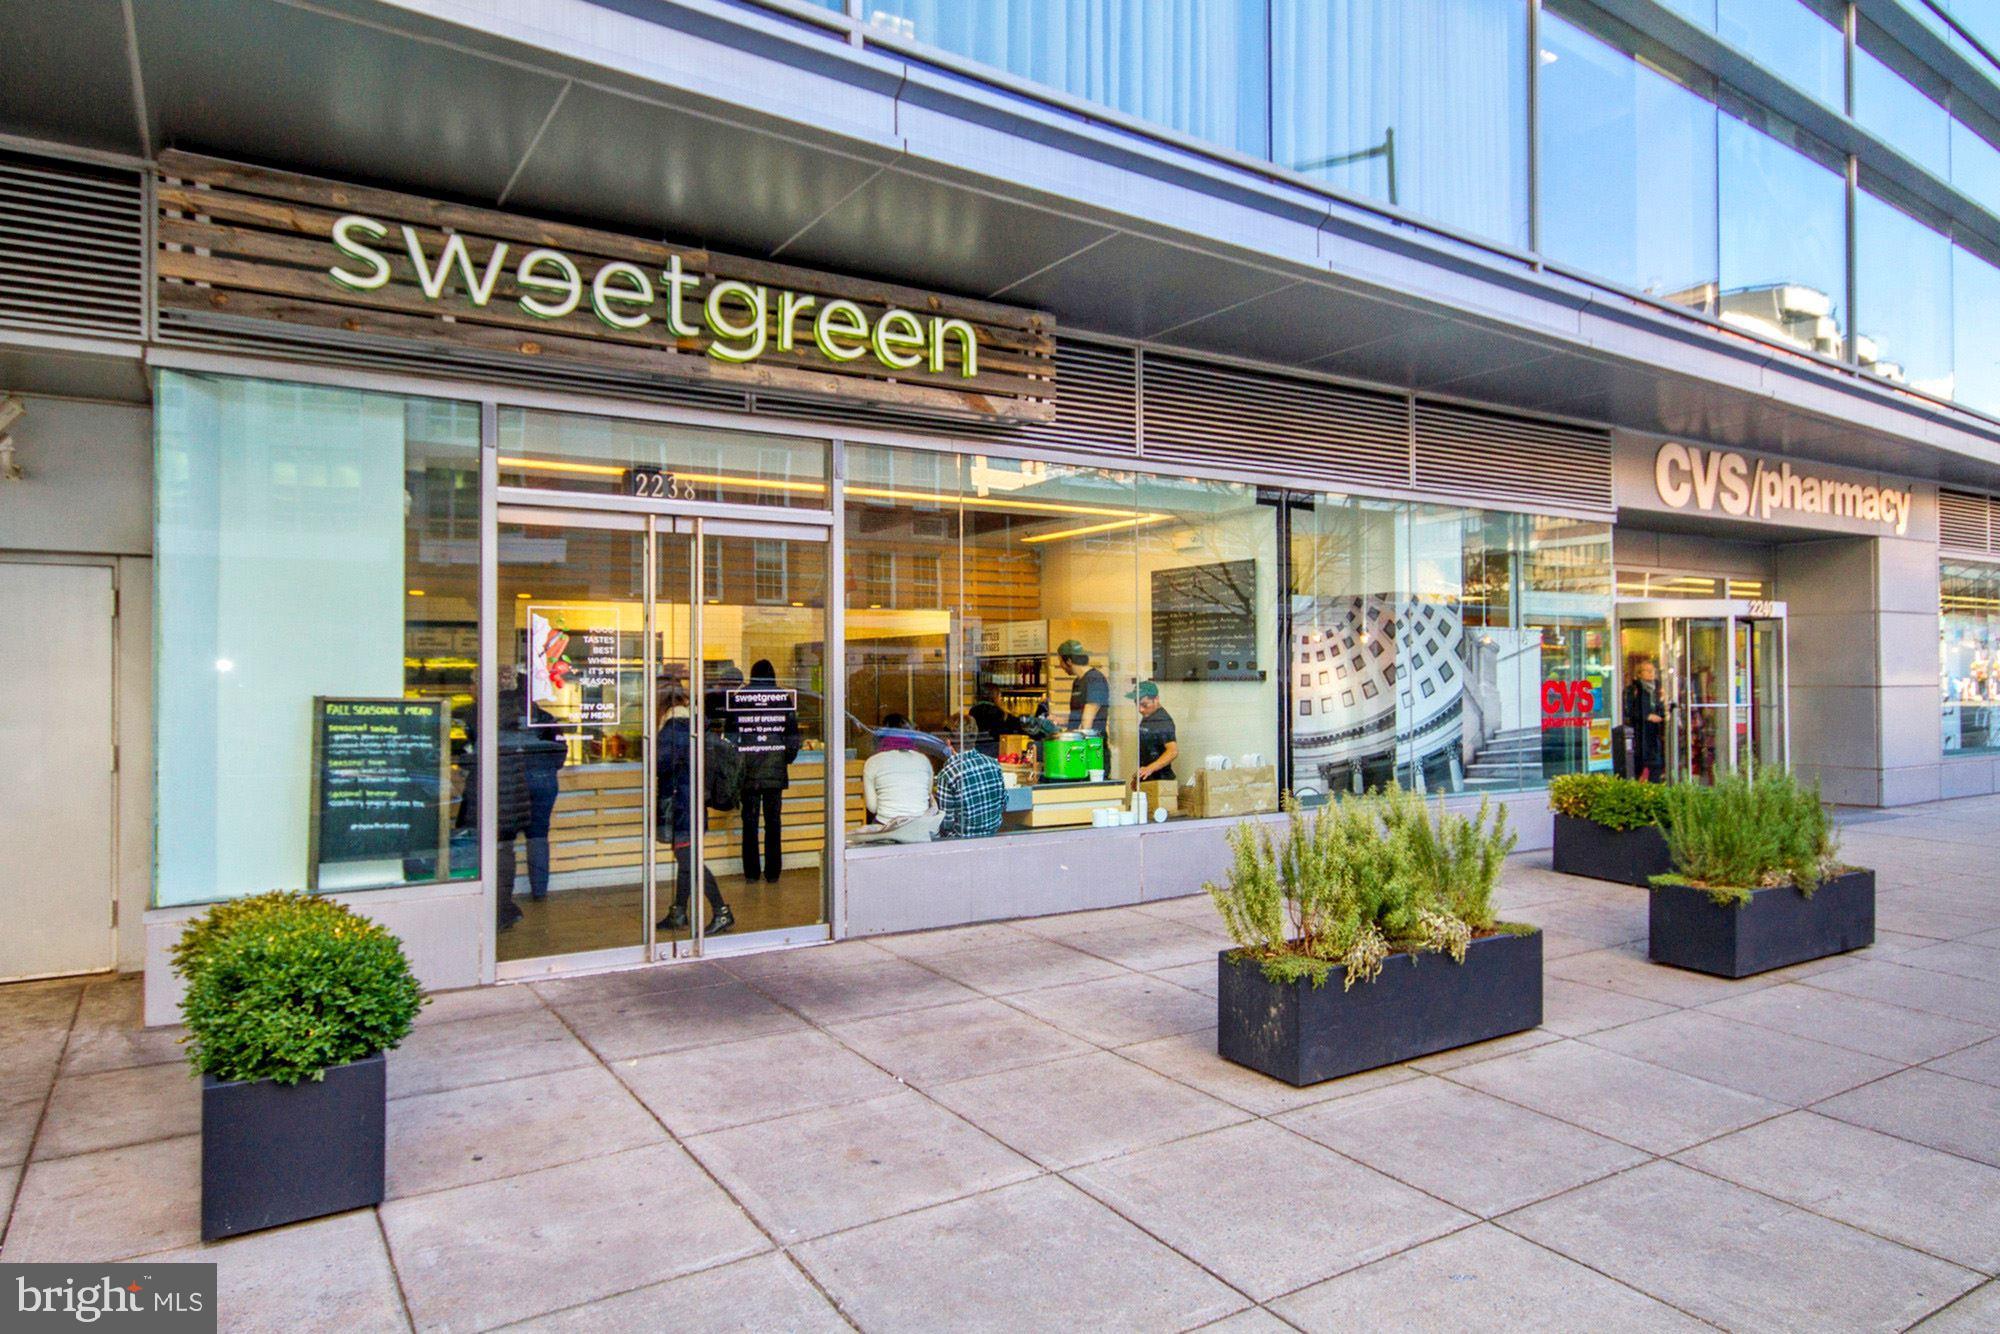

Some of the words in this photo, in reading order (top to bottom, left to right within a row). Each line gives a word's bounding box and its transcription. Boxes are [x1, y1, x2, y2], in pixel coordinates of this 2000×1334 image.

[329, 214, 978, 379] sweetgreen
[636, 473, 696, 501] 2238
[1655, 442, 1912, 535] CVS/pharmacy
[579, 703, 594, 711] TRY
[1541, 679, 1594, 714] CVS
[326, 704, 351, 715] FALL
[353, 704, 400, 715] SEASONAL
[591, 711, 614, 719] MENU
[1541, 717, 1593, 732] pharmacy
